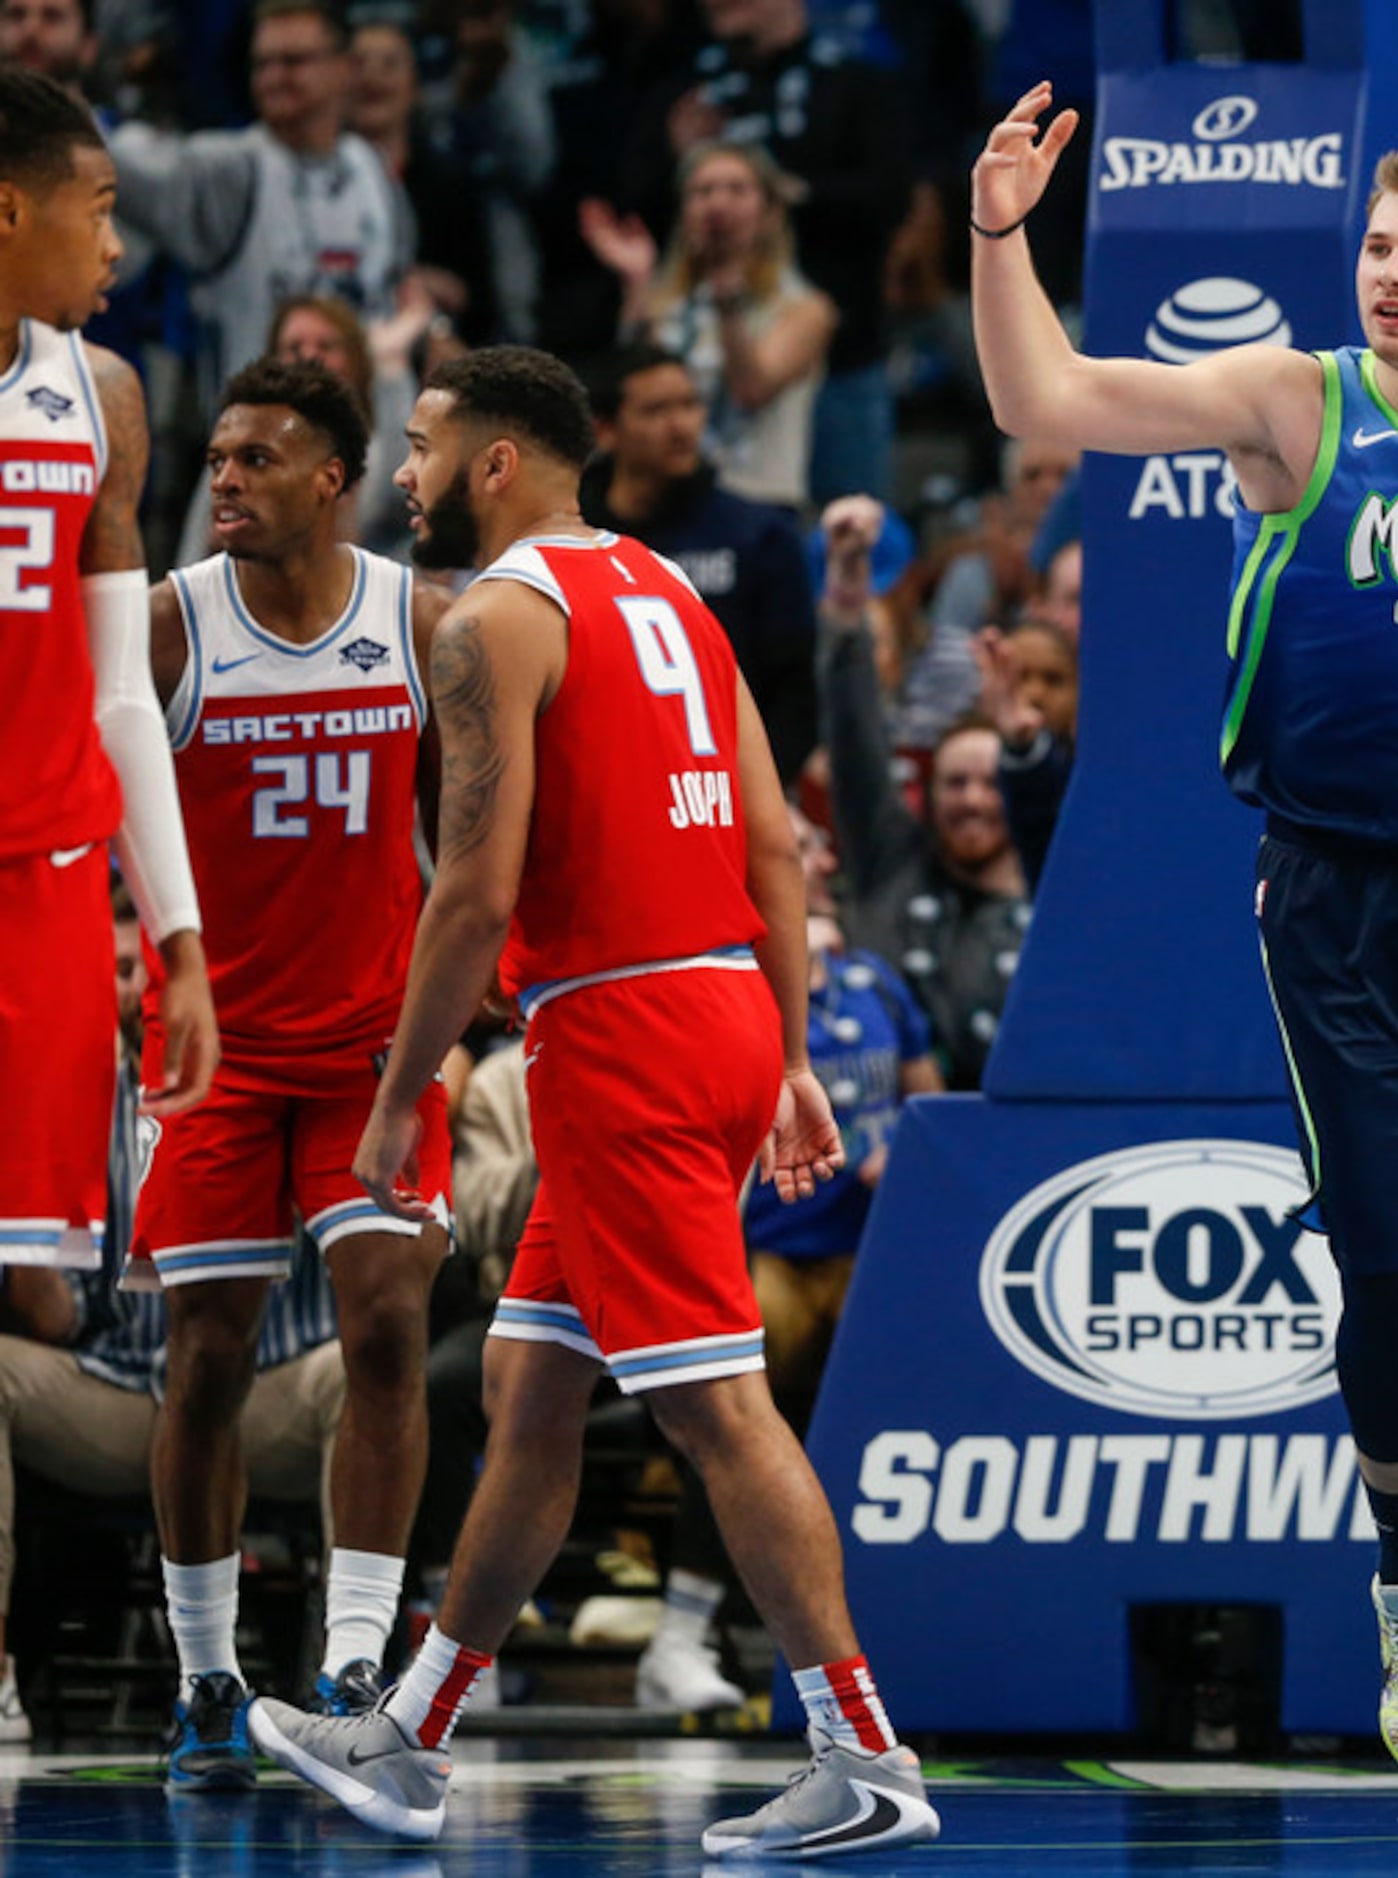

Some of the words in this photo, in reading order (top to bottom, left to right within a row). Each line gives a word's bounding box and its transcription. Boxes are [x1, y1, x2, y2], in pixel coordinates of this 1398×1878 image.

[1101, 133, 1343, 190] SPALDING
[0, 459, 95, 496] OWN
[613, 595, 718, 756] 9
[203, 703, 412, 744] SACTOWN
[252, 750, 372, 837] 24
[1088, 1205, 1322, 1307] FOX
[1086, 1313, 1324, 1352] SPORTS
